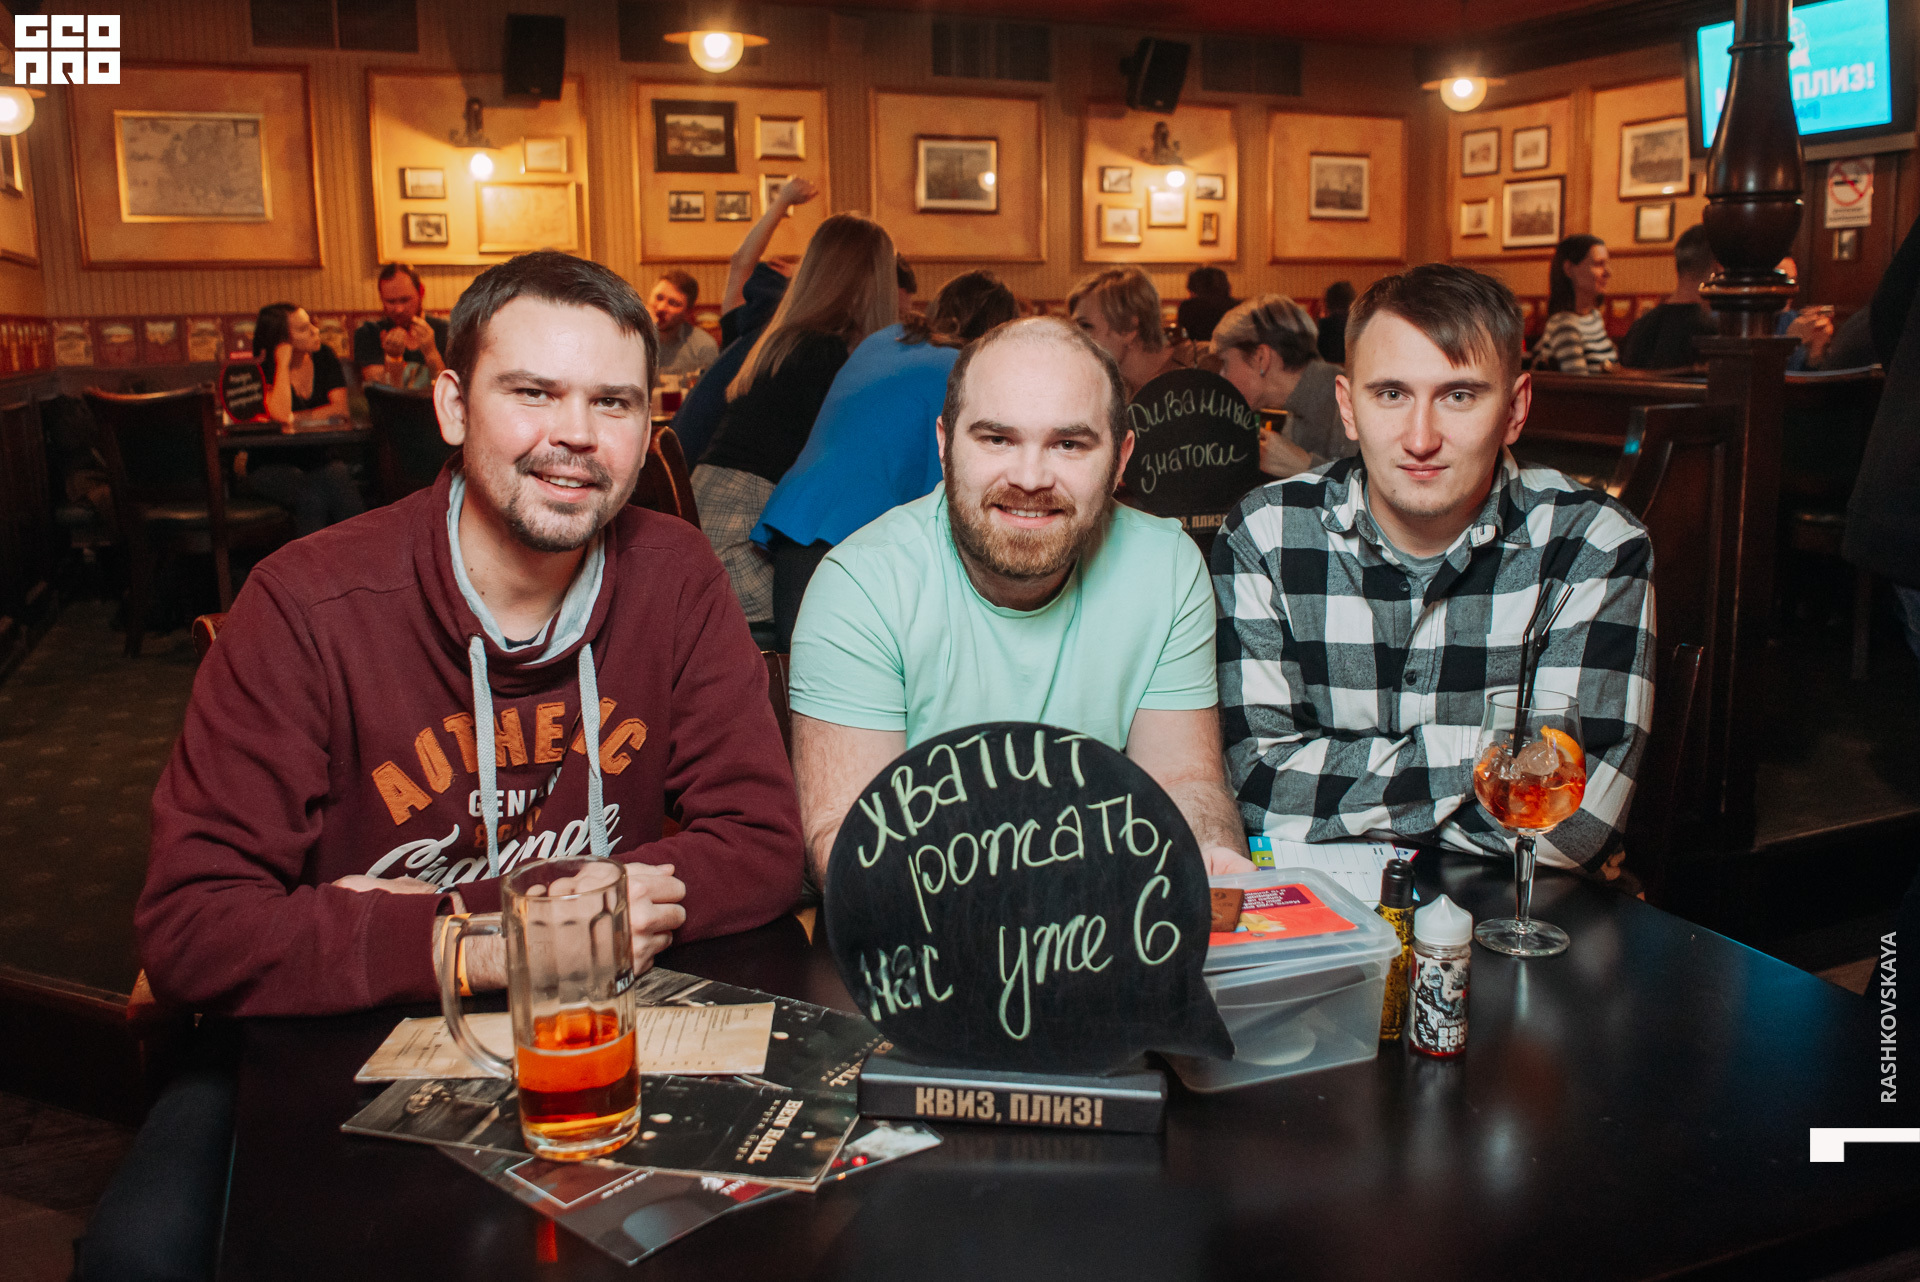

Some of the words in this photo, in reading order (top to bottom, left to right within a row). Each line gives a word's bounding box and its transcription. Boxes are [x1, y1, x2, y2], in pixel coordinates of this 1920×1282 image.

[1792, 61, 1875, 100] ПЛИЗ!
[1192, 514, 1227, 528] ПЛИЗ
[773, 1099, 804, 1128] BEN
[915, 1086, 1002, 1123] КВИЗ,
[1009, 1093, 1104, 1127] ПЛИЗ!
[747, 1128, 785, 1164] HALL
